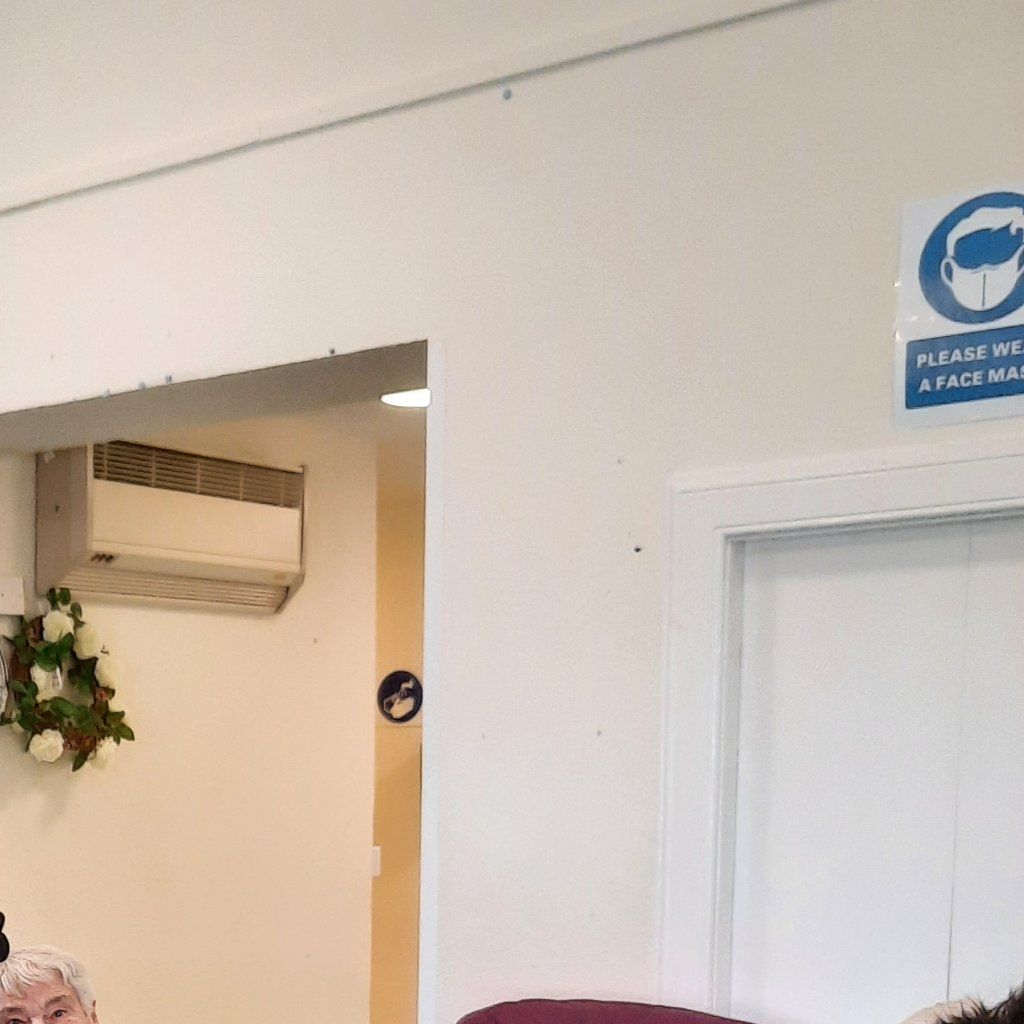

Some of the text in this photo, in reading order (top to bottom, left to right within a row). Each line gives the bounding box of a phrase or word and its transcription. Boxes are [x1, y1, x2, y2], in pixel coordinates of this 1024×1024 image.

[917, 339, 1024, 368] PLEASE WE
[918, 378, 931, 393] A
[936, 370, 983, 390] FACE
